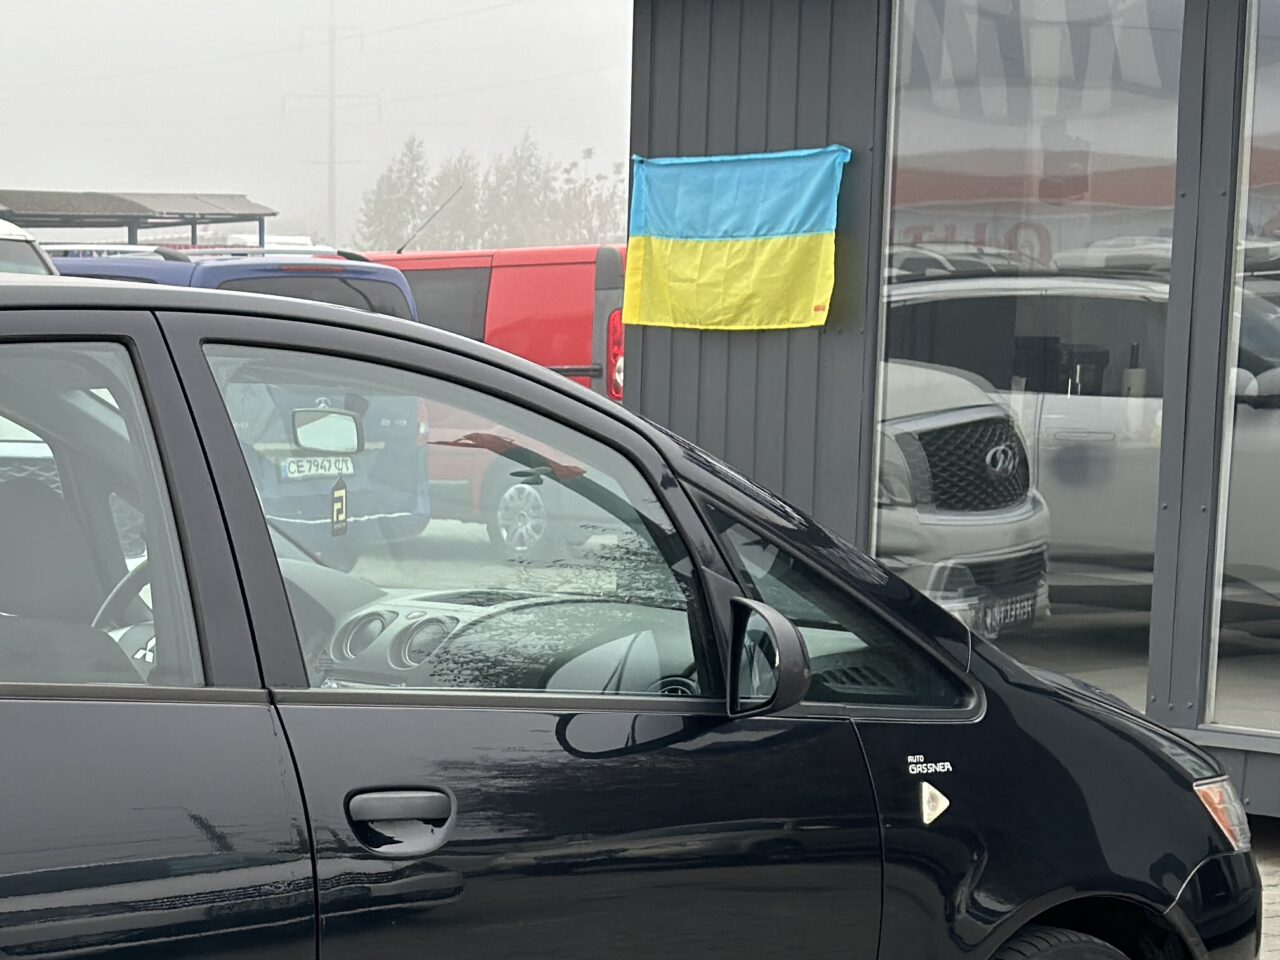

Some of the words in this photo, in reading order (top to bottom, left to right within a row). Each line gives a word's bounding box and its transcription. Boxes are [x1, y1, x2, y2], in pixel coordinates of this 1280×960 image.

[287, 458, 305, 474] CE
[306, 457, 332, 473] 7947
[907, 754, 924, 763] AUTO
[908, 762, 953, 774] GASSNER
